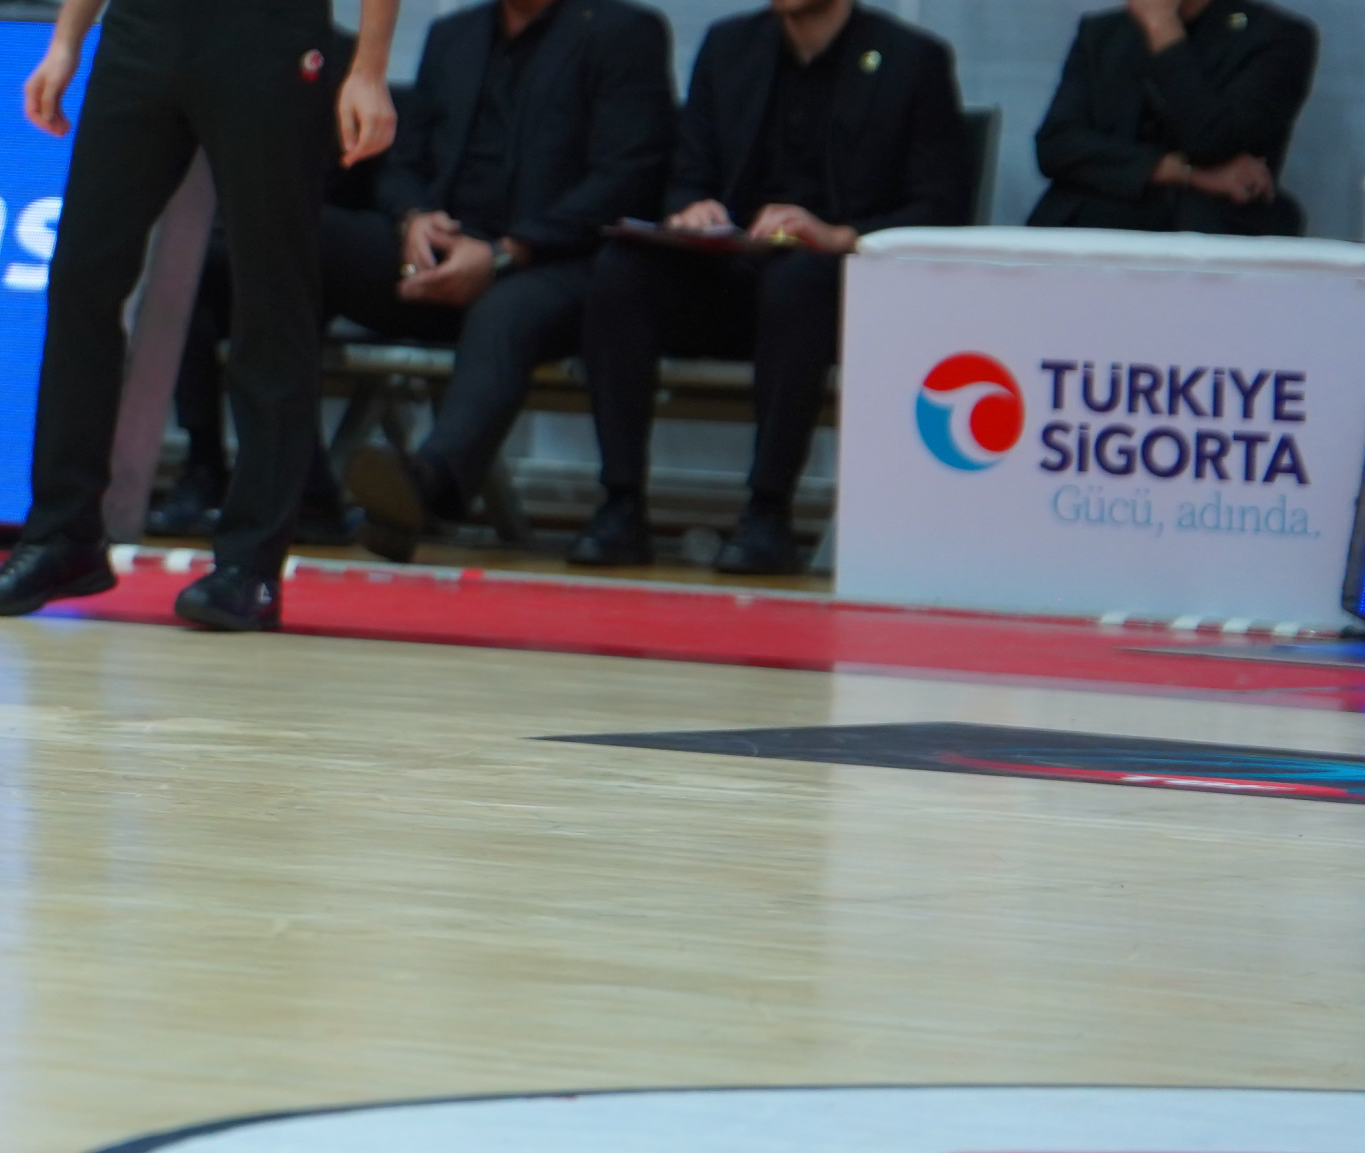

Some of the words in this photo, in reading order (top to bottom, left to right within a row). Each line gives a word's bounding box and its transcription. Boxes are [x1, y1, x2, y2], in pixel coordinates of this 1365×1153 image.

[1040, 359, 1307, 422] TÜRKİYE
[1039, 420, 1311, 485] SİGORTA
[1053, 484, 1165, 539] Gücü,
[1176, 492, 1321, 538] adında.
